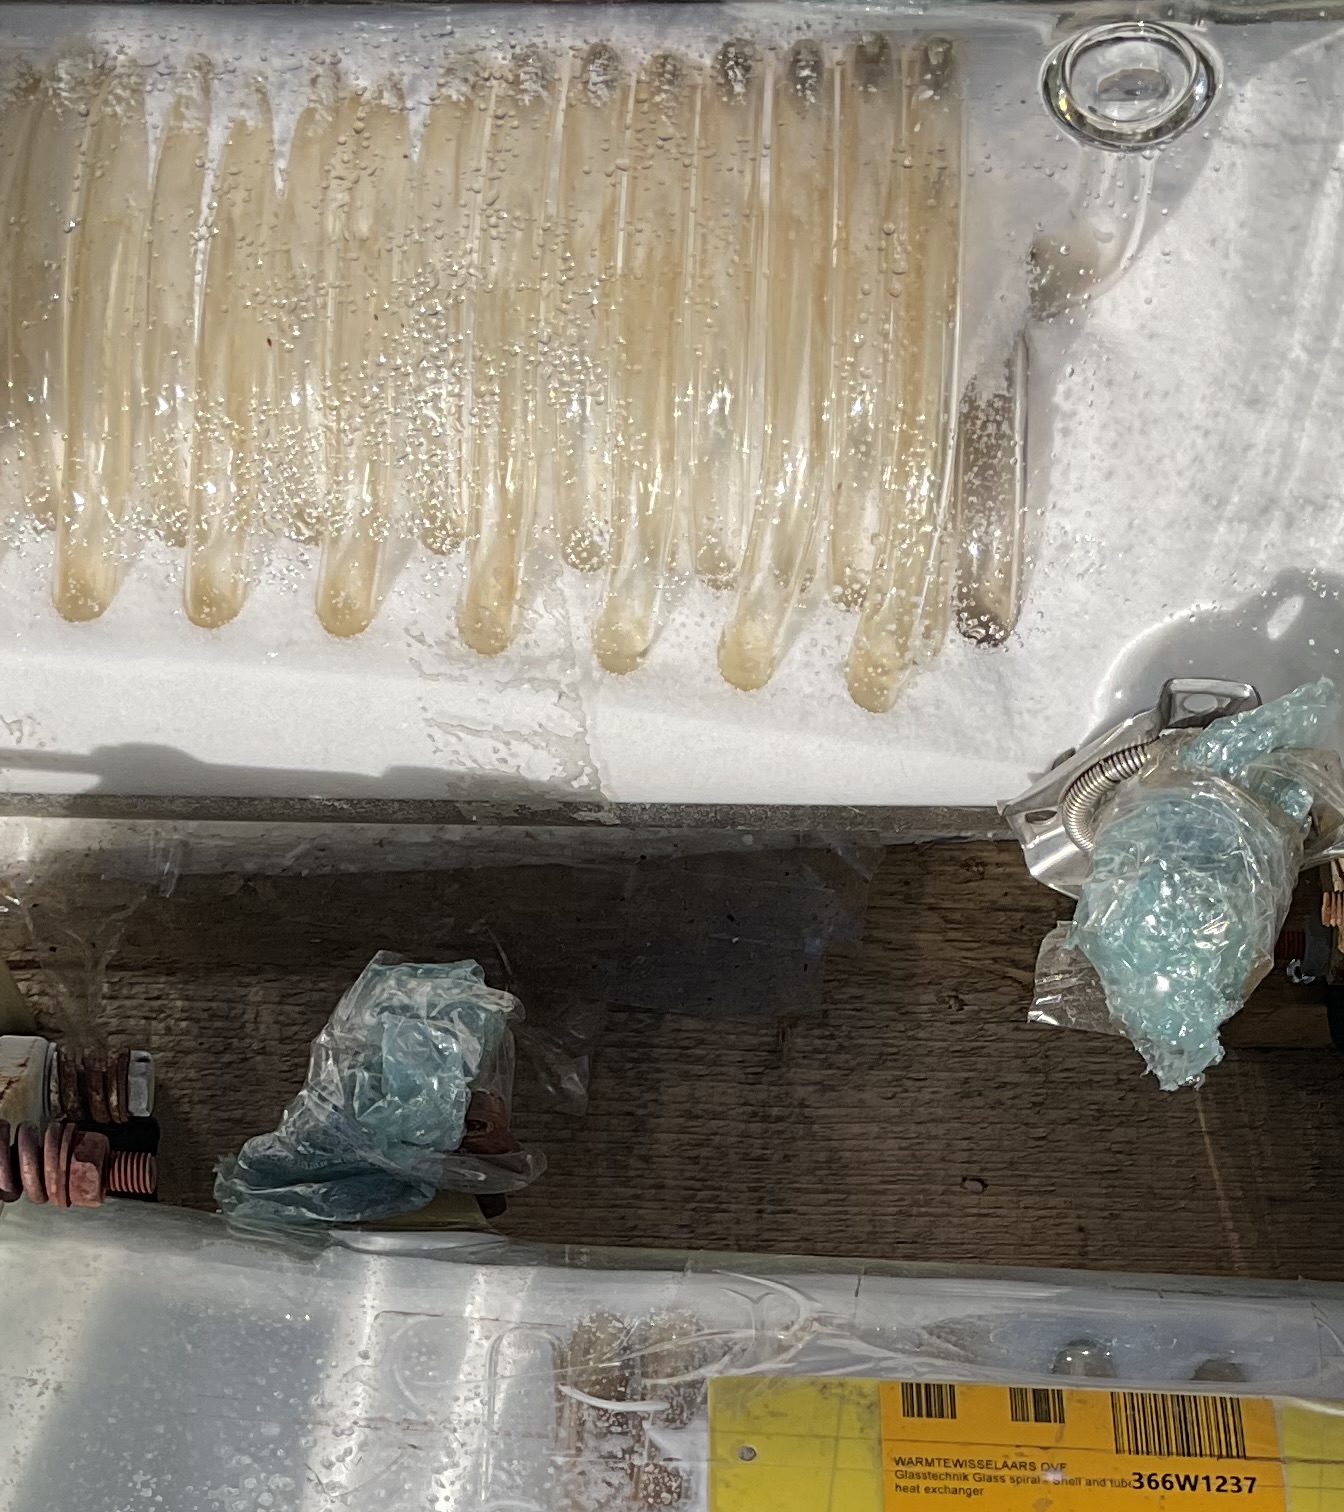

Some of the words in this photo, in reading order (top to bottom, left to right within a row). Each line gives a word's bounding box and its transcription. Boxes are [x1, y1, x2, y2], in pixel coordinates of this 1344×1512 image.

[893, 1456, 1037, 1472] WARMTEWISSELAARS
[894, 1469, 970, 1483] Glasstechnik
[972, 1472, 1006, 1484] Glass
[1009, 1474, 1041, 1487] spiral
[1085, 1477, 1106, 1488] and
[1131, 1472, 1257, 1494] 366W1237
[894, 1483, 921, 1494] heat
[923, 1485, 985, 1498] exchanger
